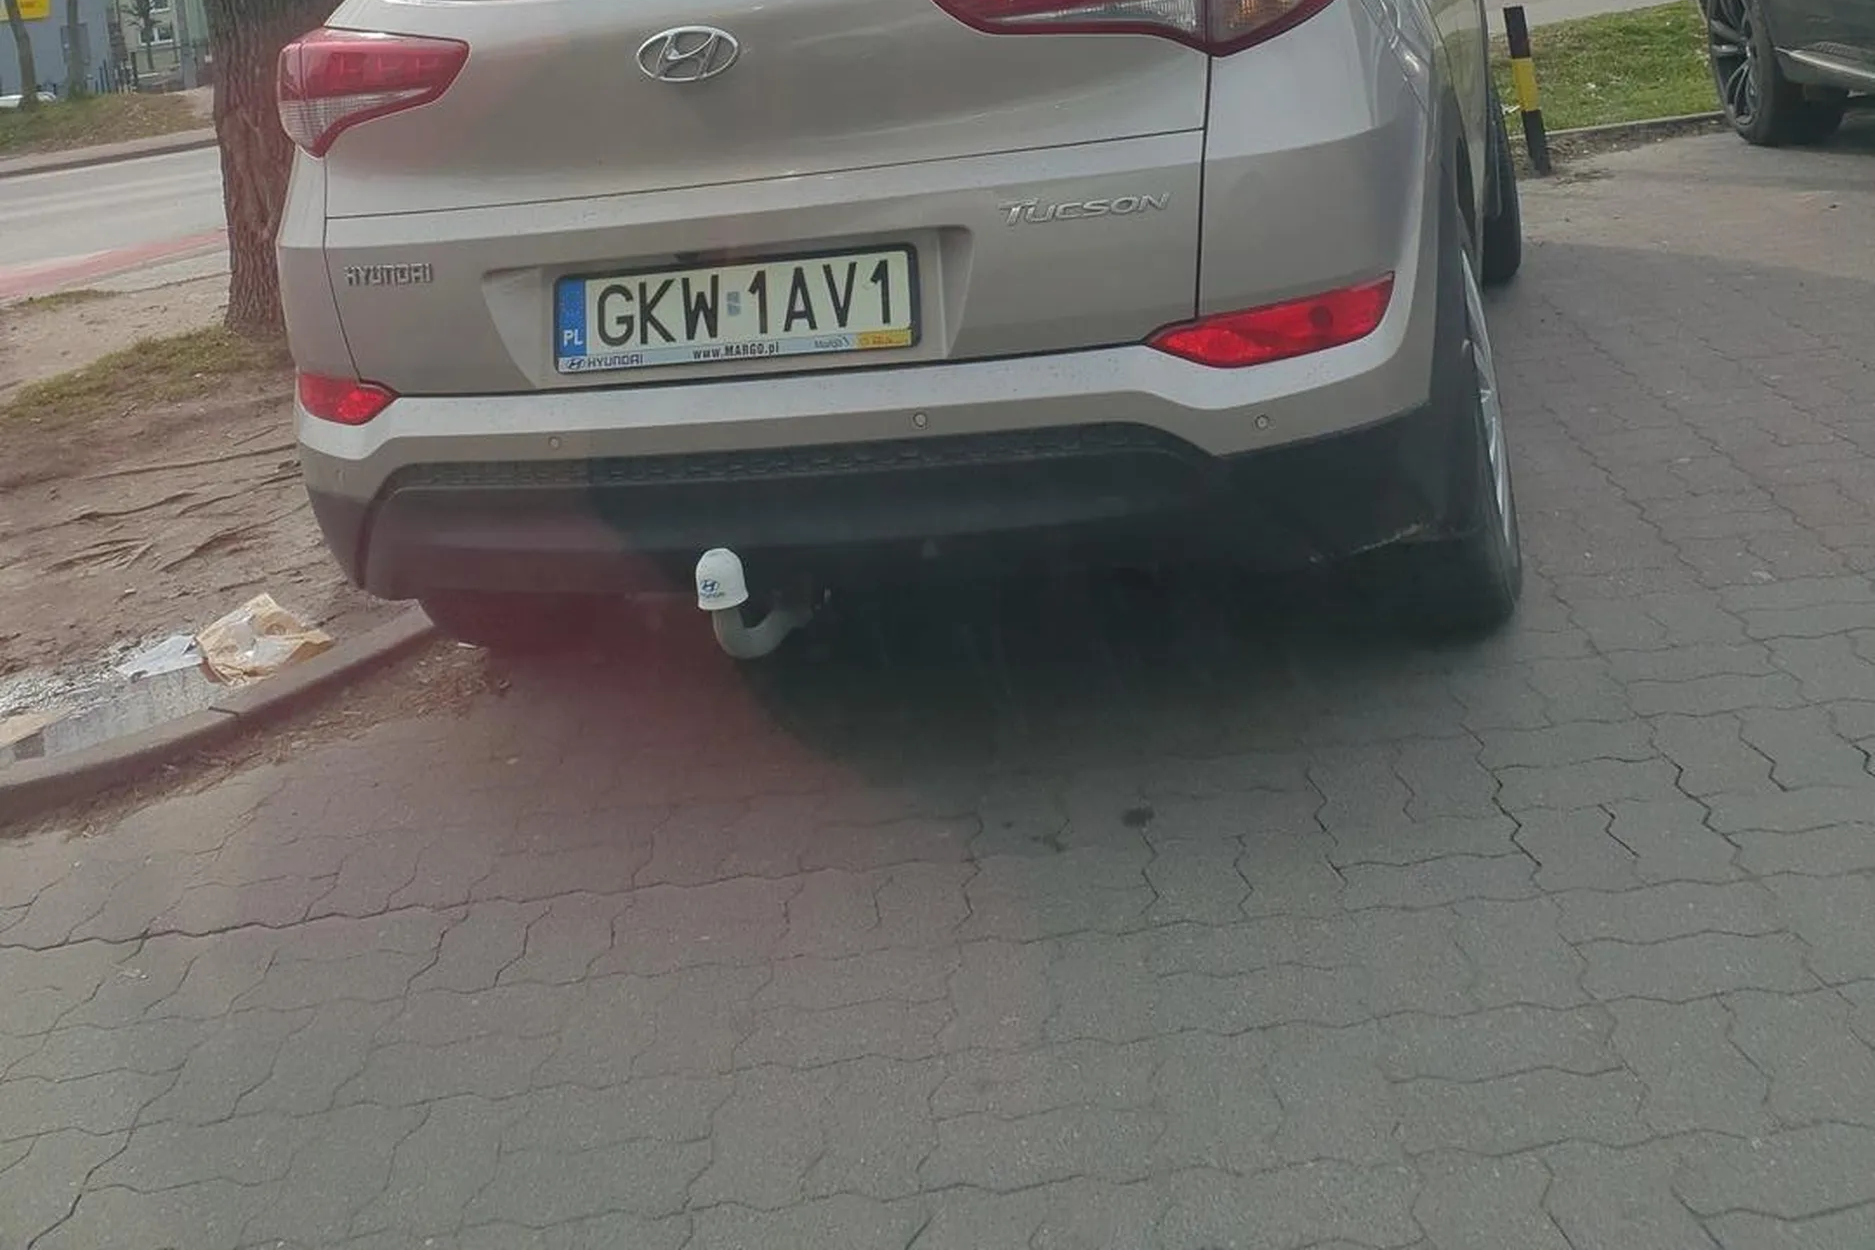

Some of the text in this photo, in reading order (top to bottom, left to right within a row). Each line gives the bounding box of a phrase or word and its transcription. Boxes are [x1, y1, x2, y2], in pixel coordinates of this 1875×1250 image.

[998, 192, 1171, 226] TUCSON
[343, 263, 433, 286] HYUNDAI
[597, 258, 891, 348] GKW 1AV1
[563, 330, 583, 347] PL
[587, 353, 644, 368] HYUNDAI
